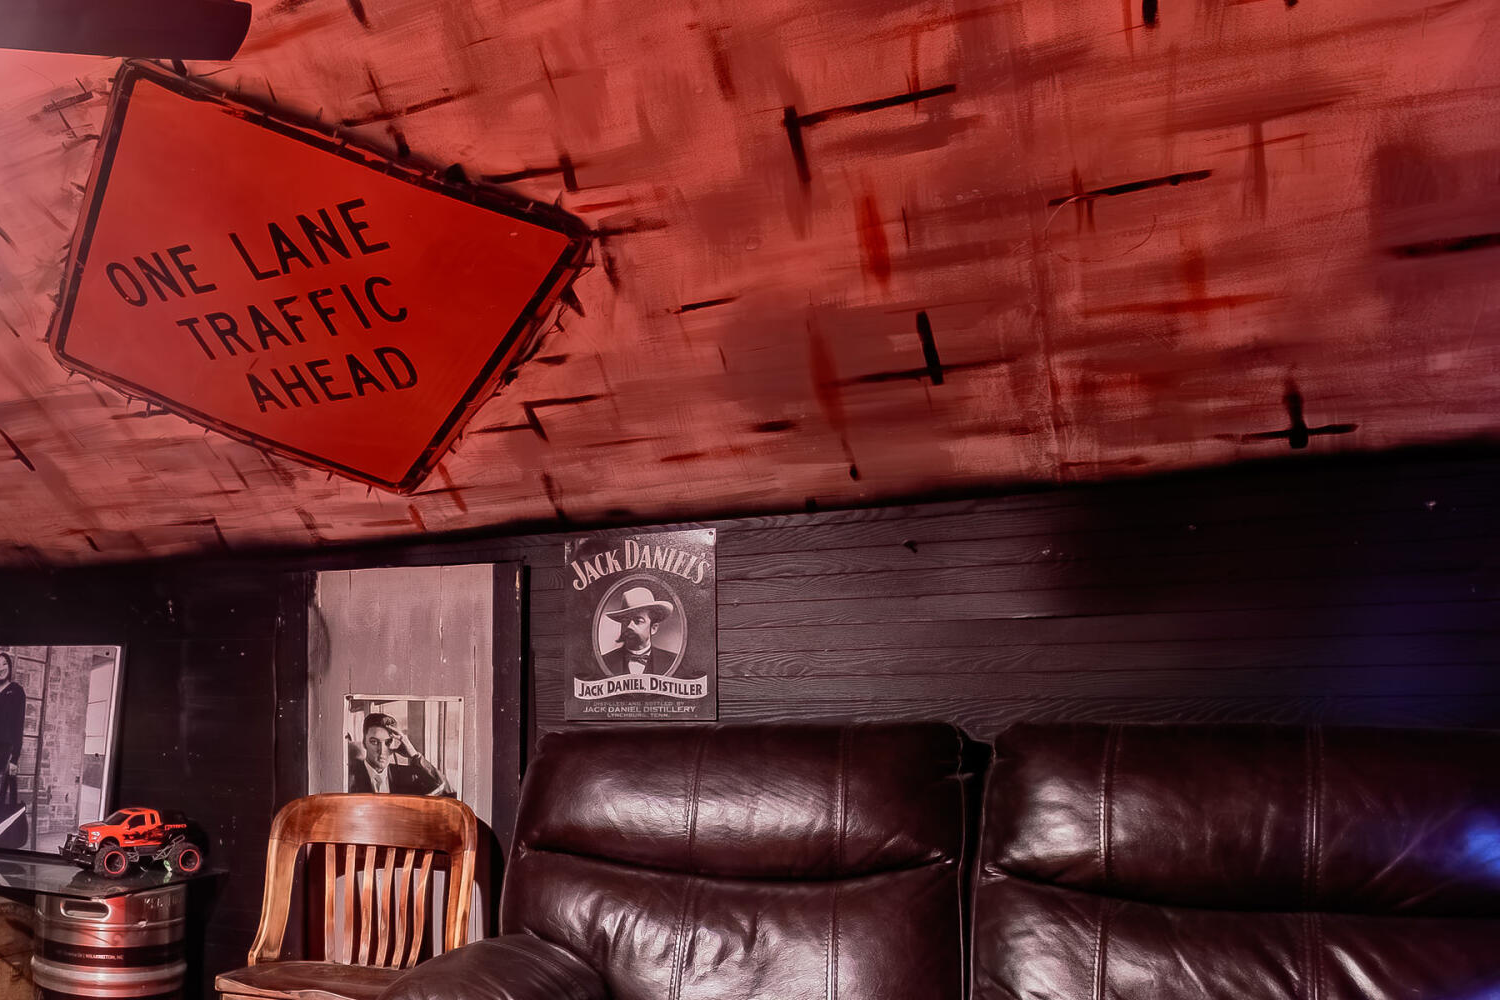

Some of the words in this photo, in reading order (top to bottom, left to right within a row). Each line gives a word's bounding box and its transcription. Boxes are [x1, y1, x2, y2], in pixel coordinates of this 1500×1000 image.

[106, 243, 217, 307] ONE
[229, 198, 390, 281] LANE
[177, 275, 409, 361] TRAFFIC
[245, 346, 418, 413] AHEAD
[570, 549, 620, 591] JACK
[624, 539, 712, 584] DANIEL'S
[579, 683, 604, 697] JACK
[649, 677, 703, 696] DISTILLER
